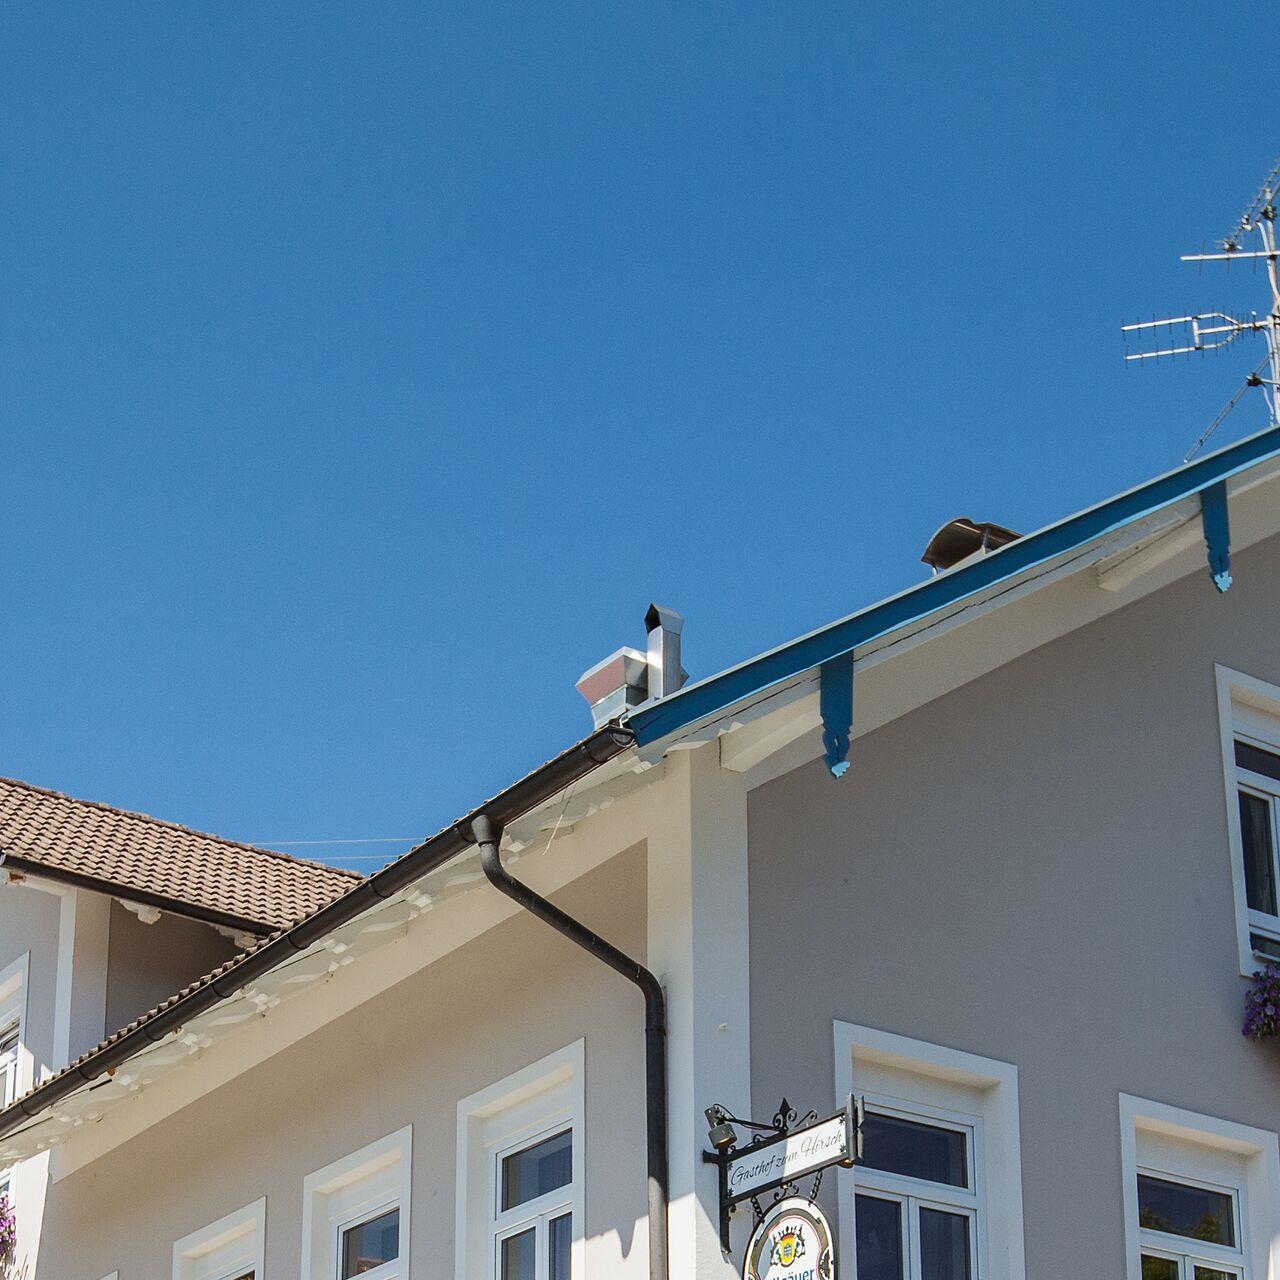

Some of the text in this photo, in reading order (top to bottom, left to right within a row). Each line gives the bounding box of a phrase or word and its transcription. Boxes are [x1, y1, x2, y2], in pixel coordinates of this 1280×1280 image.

[730, 1129, 842, 1187] Gasthof zum Hirsch
